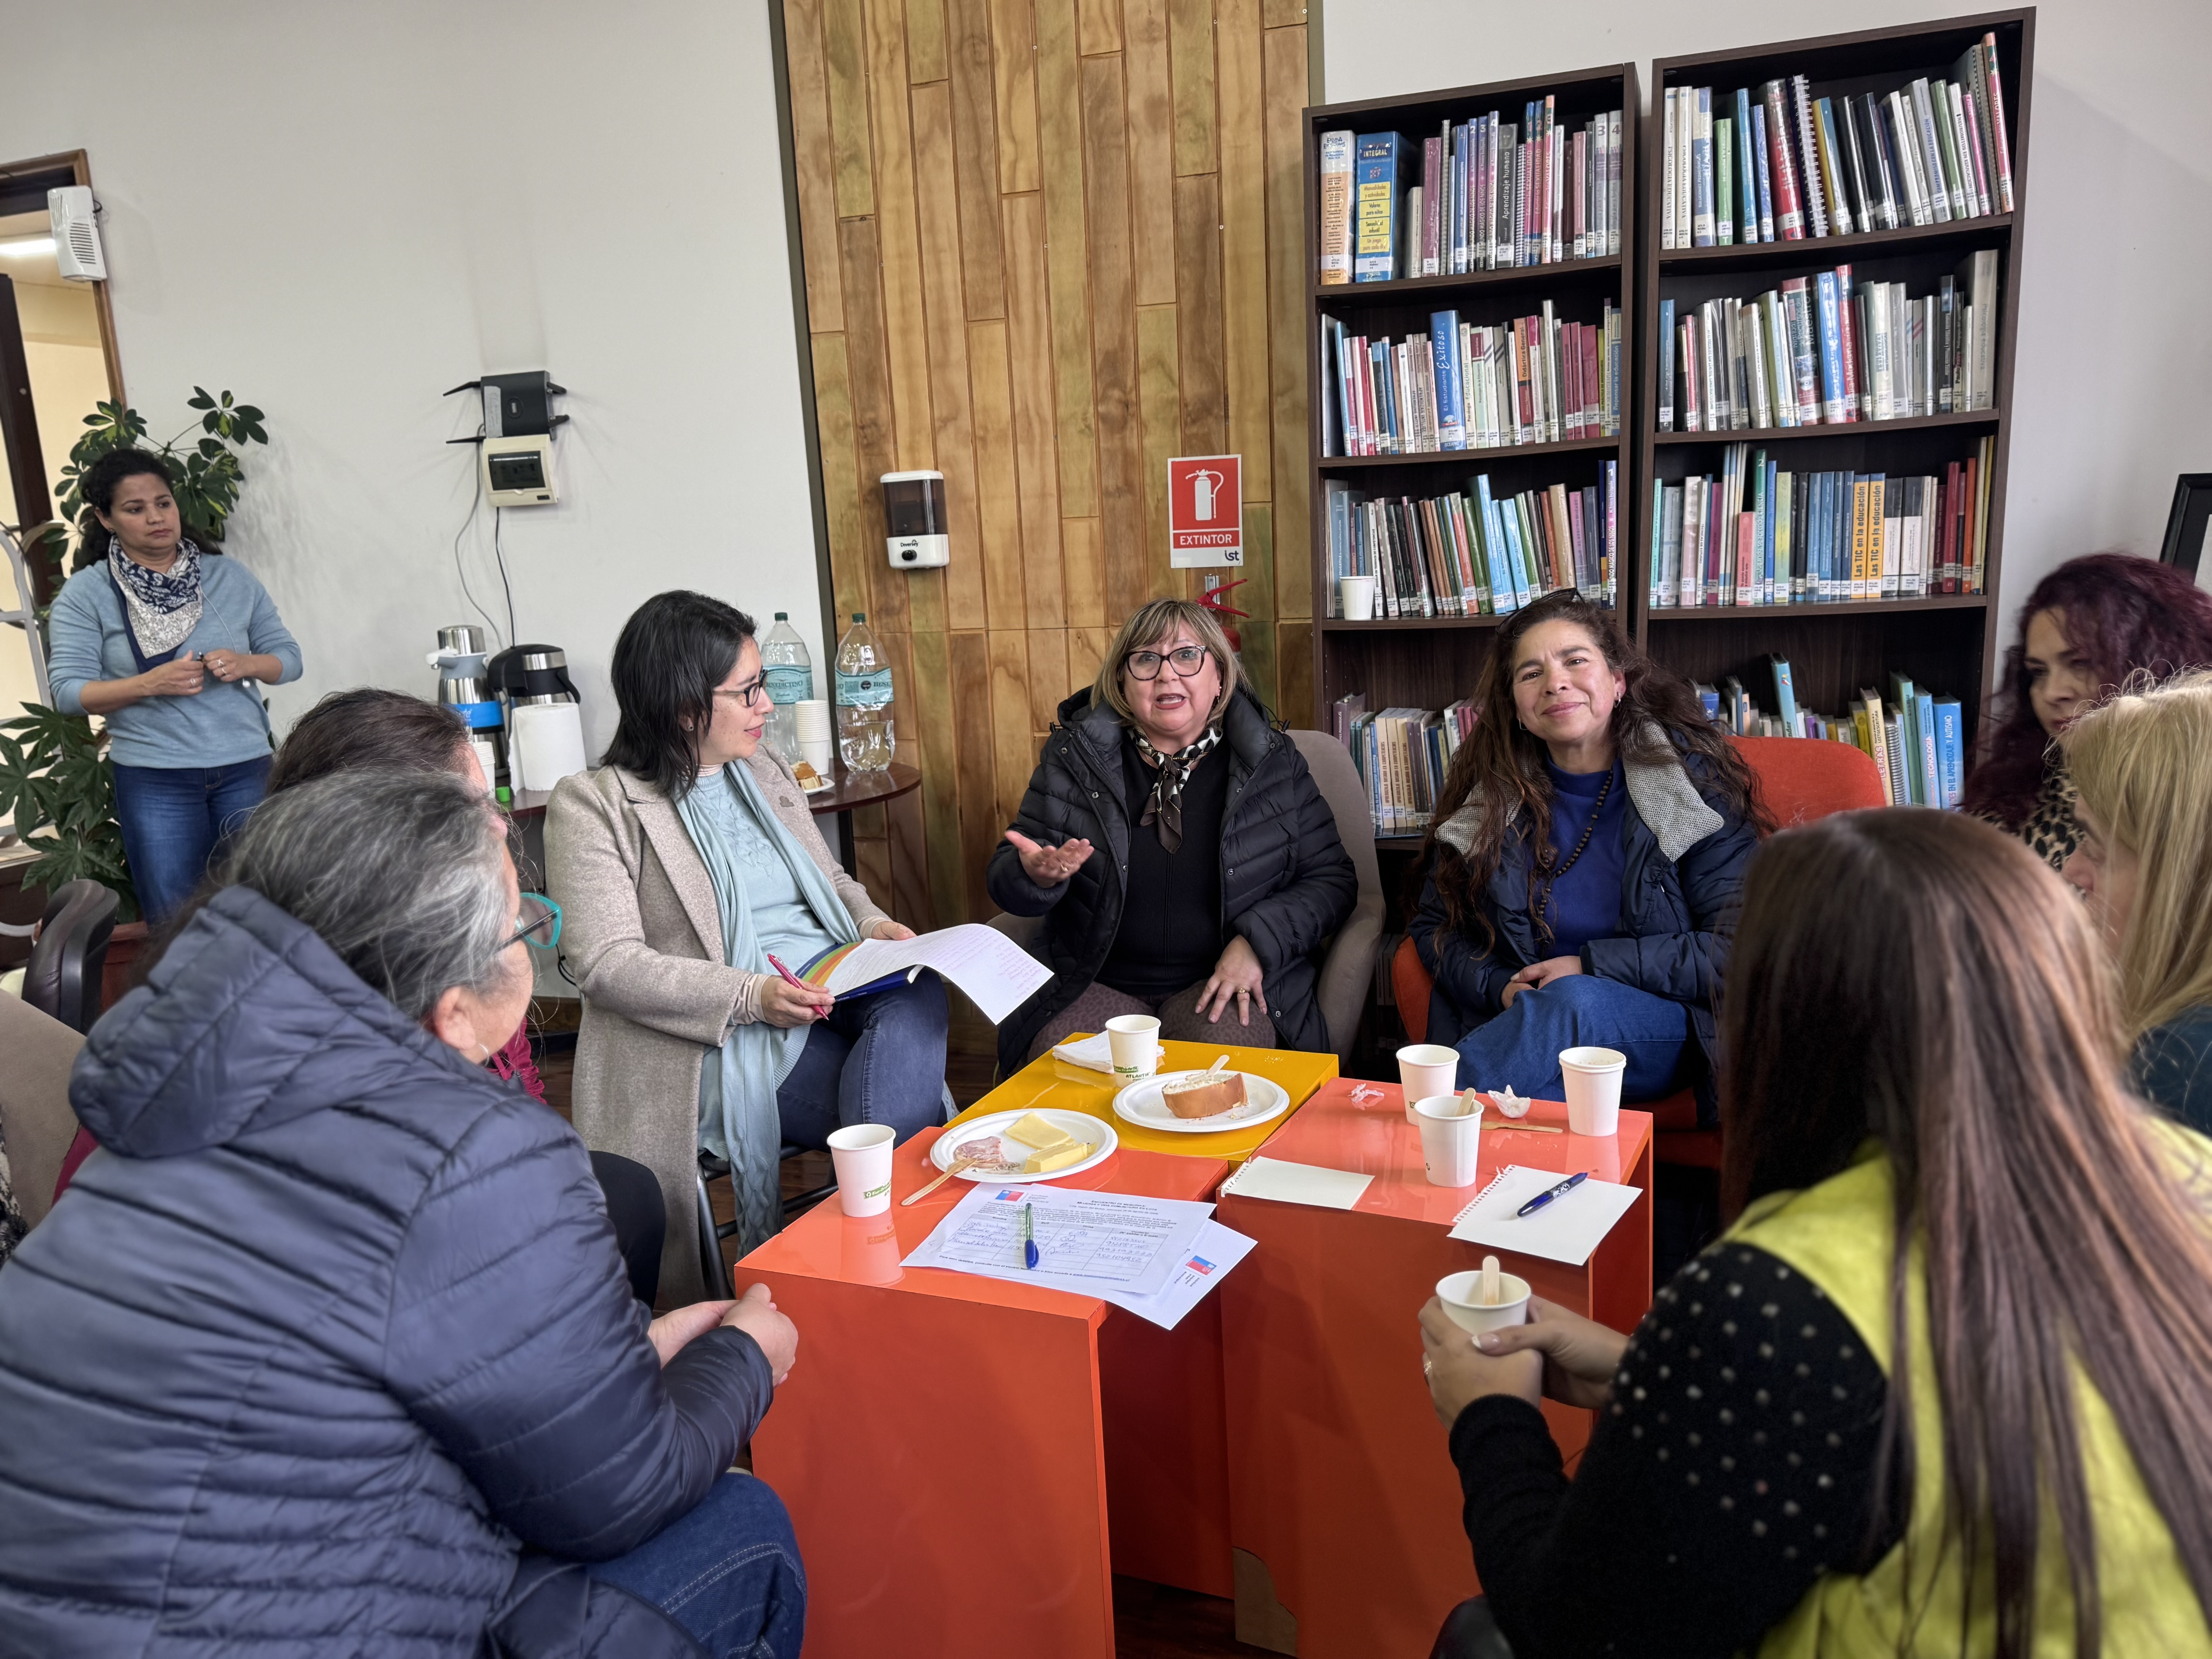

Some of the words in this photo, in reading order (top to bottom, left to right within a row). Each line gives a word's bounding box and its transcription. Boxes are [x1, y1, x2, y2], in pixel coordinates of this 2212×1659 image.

[1480, 124, 1486, 132] 3
[1491, 119, 1498, 127] 4
[1536, 120, 1542, 130] 2
[1598, 125, 1606, 136] 3
[1611, 124, 1620, 134] 4
[1924, 118, 1933, 145] EDUCACIÓN
[1957, 117, 1966, 150] NEUROMITOS
[1932, 163, 1942, 194] COMPROMISO
[1502, 179, 1511, 219] Aprendizaje
[1804, 296, 1815, 345] Maestro
[1436, 330, 1450, 369] Exitoso
[1845, 342, 1854, 380] Moderna
[1856, 486, 1865, 526] educación
[1872, 485, 1881, 526] educación
[1180, 534, 1232, 546] EXTINTOR
[1857, 538, 1863, 547] en
[1873, 538, 1879, 547] en
[1224, 550, 1239, 561] ist
[1871, 549, 1879, 562] TIC
[1870, 563, 1879, 576] Las
[1944, 715, 1953, 738] AUTISMO
[1875, 746, 1886, 778] LETRAS
[1923, 735, 1935, 779] TECNOLOGÍA
[1946, 744, 1955, 777] APRENDIZAJE
